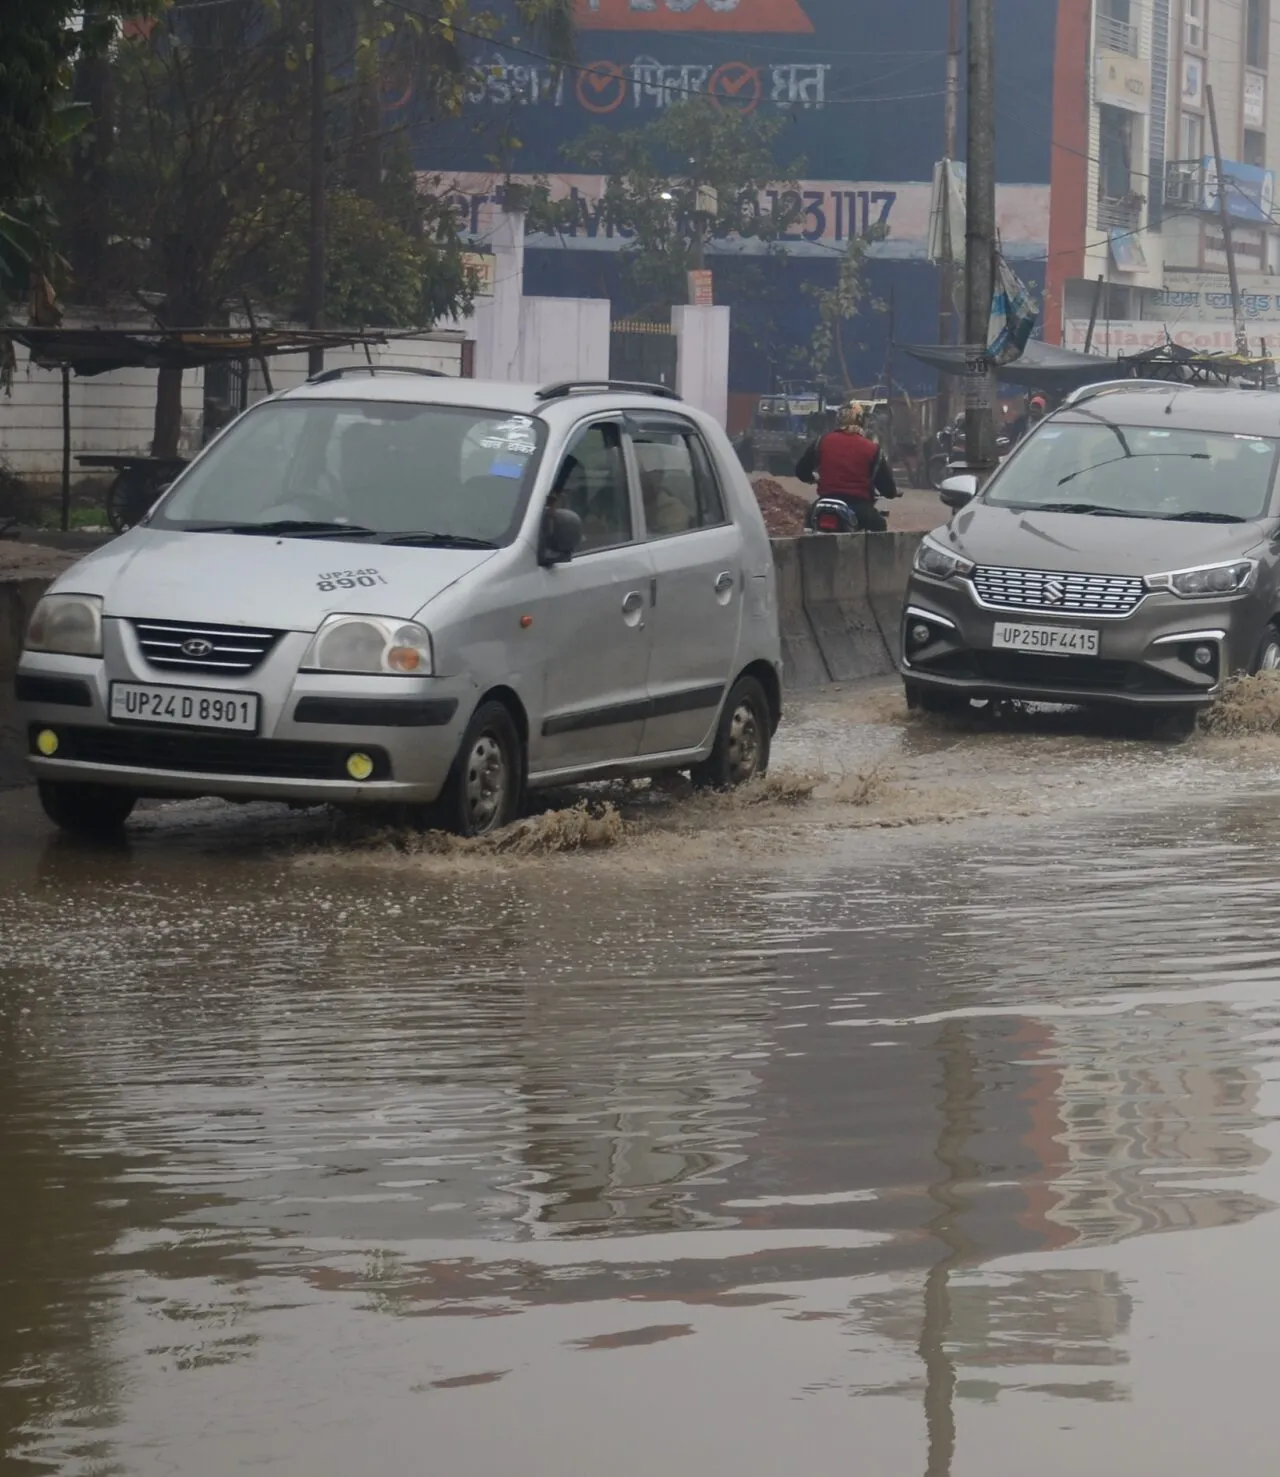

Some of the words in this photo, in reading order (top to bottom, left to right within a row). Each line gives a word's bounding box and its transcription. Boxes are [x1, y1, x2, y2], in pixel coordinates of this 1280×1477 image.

[316, 575, 388, 592] 8901
[125, 691, 176, 717] UP24
[181, 696, 193, 718] D
[199, 698, 249, 724] 8901
